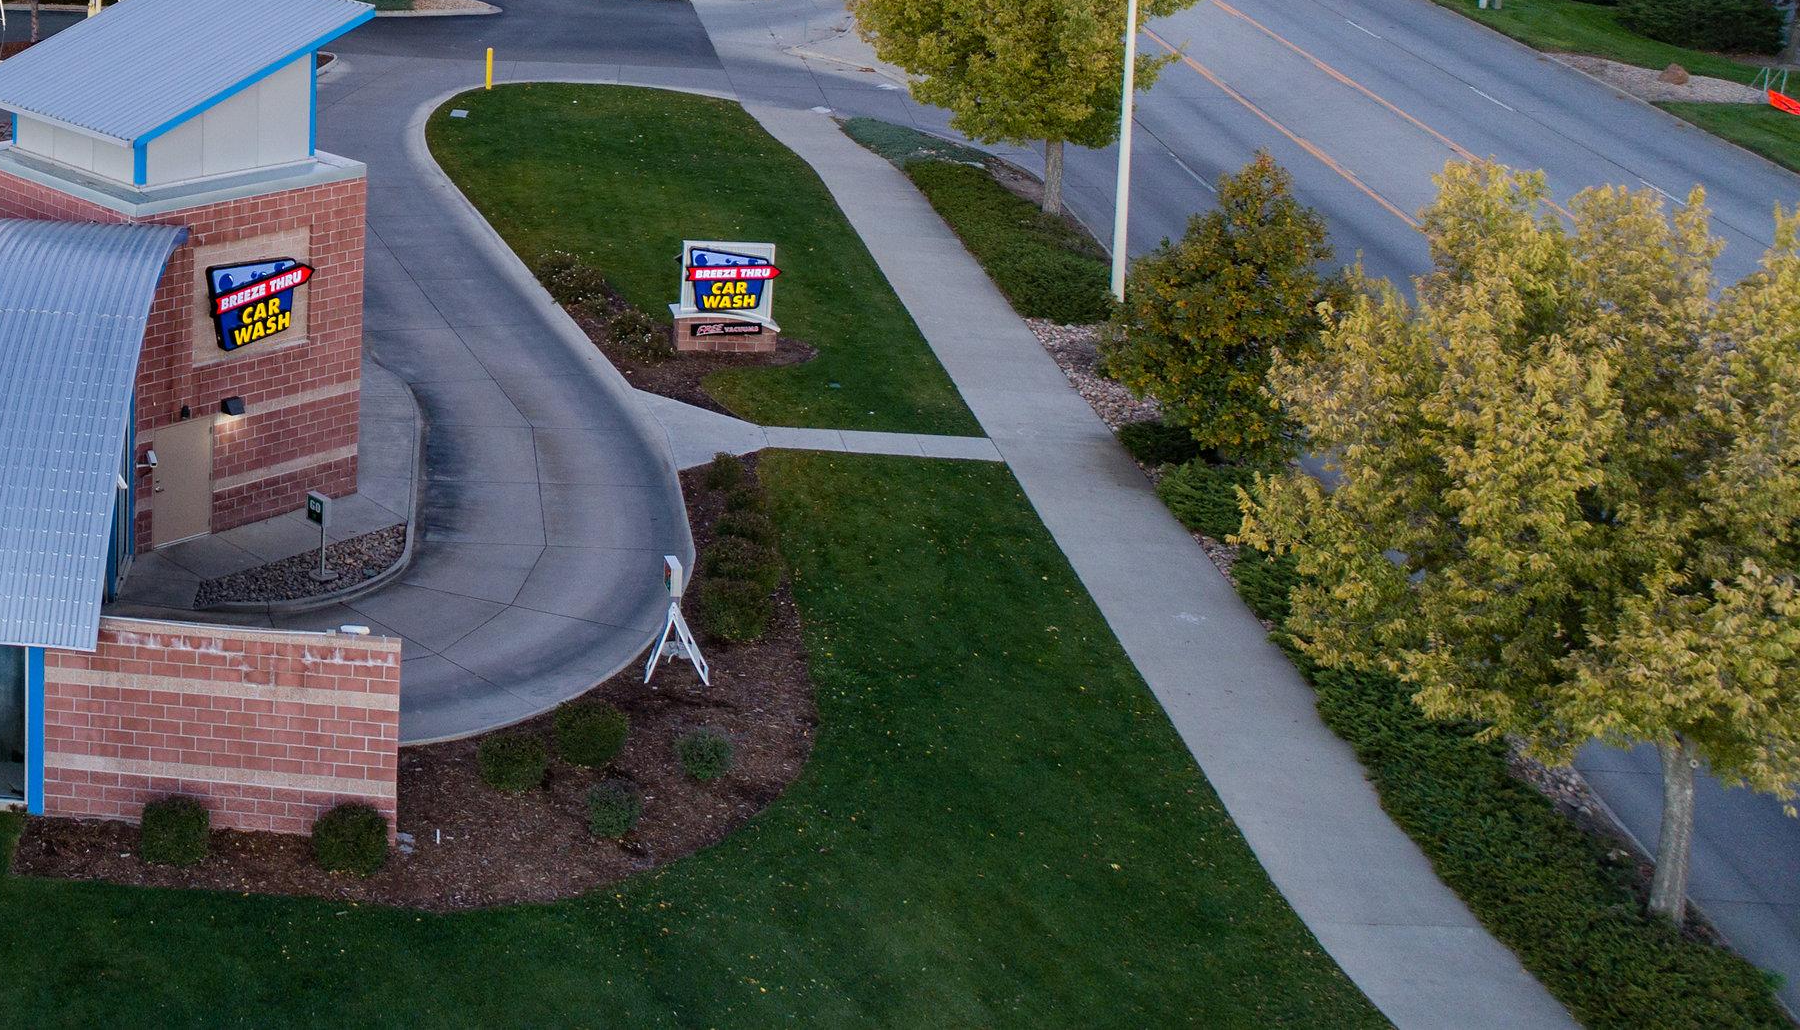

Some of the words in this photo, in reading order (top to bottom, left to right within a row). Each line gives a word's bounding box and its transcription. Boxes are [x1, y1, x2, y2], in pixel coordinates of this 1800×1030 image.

[695, 269, 737, 278] BREEZE
[740, 268, 771, 277] THRU
[221, 283, 266, 310] BREEZE
[270, 270, 302, 292] THRU
[711, 281, 748, 295] CAR
[703, 294, 756, 309] WASH
[242, 297, 280, 325] CAR
[234, 311, 291, 346] WASH
[309, 499, 321, 514] GO
